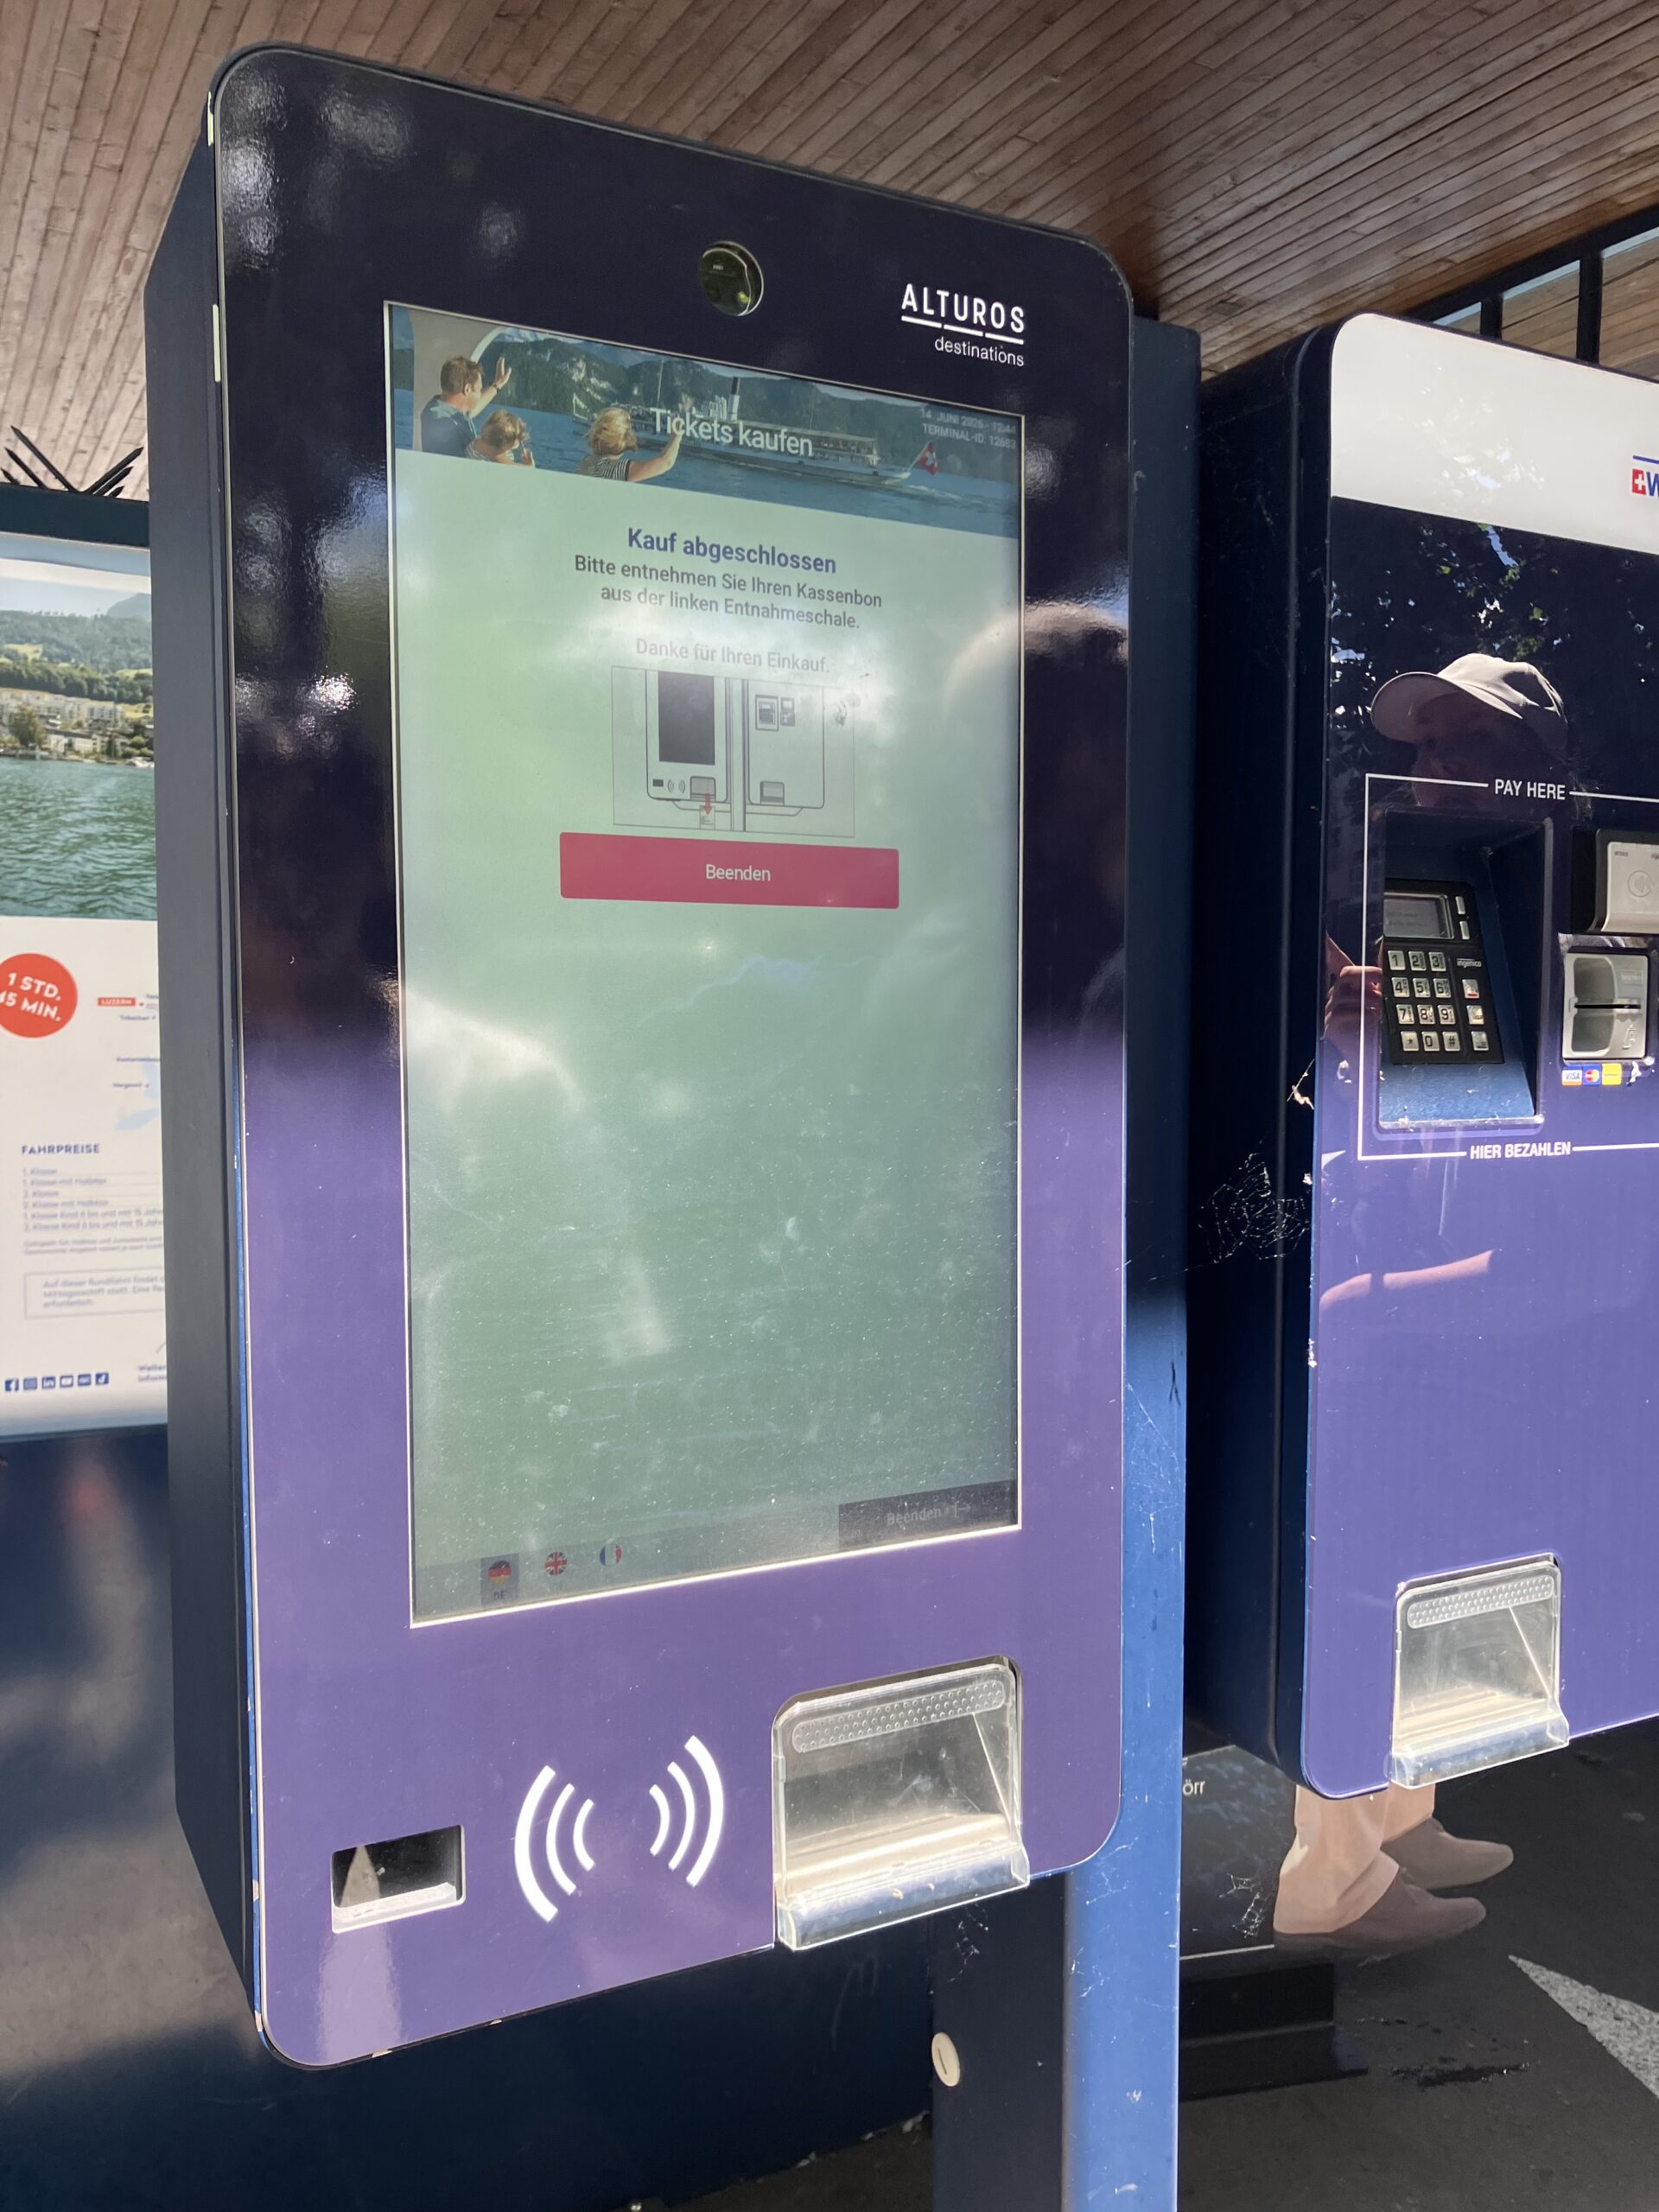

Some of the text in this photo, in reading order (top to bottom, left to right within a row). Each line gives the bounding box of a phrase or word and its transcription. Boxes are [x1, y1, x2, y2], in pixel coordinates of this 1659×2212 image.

[900, 283, 1025, 334] ALTUROS
[934, 335, 1025, 367] destinations
[937, 411, 960, 425] JUNI
[649, 406, 814, 458] Tickets kaufen
[627, 527, 836, 574] Kauf abgeschlossen
[574, 554, 883, 608] Bitte entnehmen Sie Ihren Kassenbon
[600, 586, 861, 629] aus der linken Entnahmeschale.
[635, 638, 830, 675] Danke für Ihren Einkauf.
[1494, 779, 1566, 800] PAY HERE
[705, 863, 772, 882] Beenden
[1391, 954, 1398, 967] 1
[1411, 955, 1420, 967] 2
[1431, 955, 1440, 968] 3
[8, 972, 62, 1001] 1 STD.
[1395, 982, 1403, 994] 4
[1416, 981, 1424, 994] 5
[1436, 982, 1444, 995] 6
[21, 997, 62, 1022] MIN.
[1399, 1007, 1407, 1020] 7
[1420, 1008, 1428, 1020] 8
[1440, 1008, 1449, 1020] 9
[1425, 1035, 1433, 1047] 0
[1565, 1071, 1580, 1080] VISA
[22, 1143, 100, 1155] FAHRPREISE
[1470, 1141, 1572, 1160] HIER BEZAHLEN
